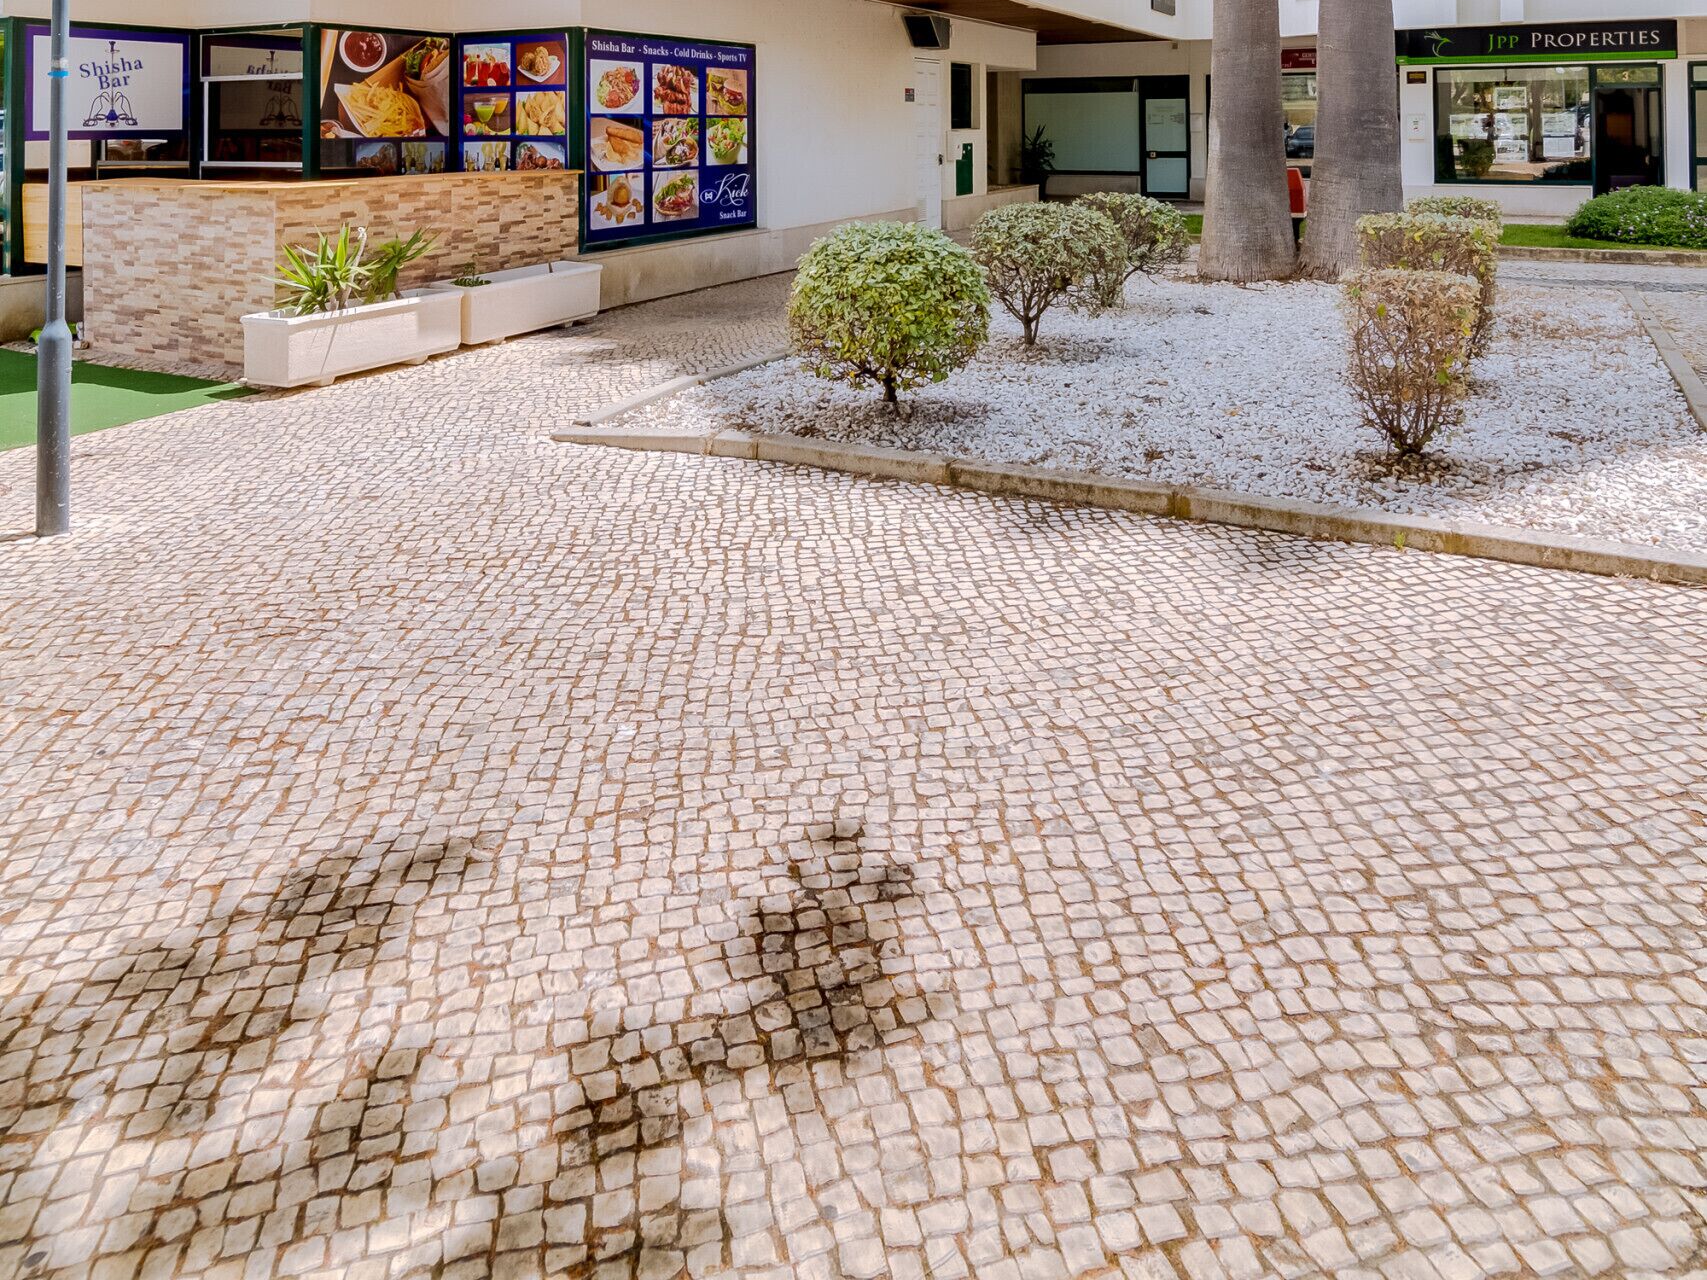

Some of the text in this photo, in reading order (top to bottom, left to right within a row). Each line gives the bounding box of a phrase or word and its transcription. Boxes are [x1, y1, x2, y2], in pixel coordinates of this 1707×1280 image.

[1531, 30, 1661, 48] PROPERTIES
[592, 40, 619, 52] Shisha
[621, 43, 635, 53] Bar
[643, 45, 669, 56] Snacks
[674, 48, 690, 58] Cold
[691, 49, 713, 60] Drinks
[718, 52, 738, 62] Sports
[738, 54, 747, 62] TV
[79, 57, 143, 78] Shisha
[1622, 71, 1629, 81] 3
[98, 74, 130, 90] Bar
[714, 173, 750, 206] Kick
[720, 210, 747, 219] Snack Bar
